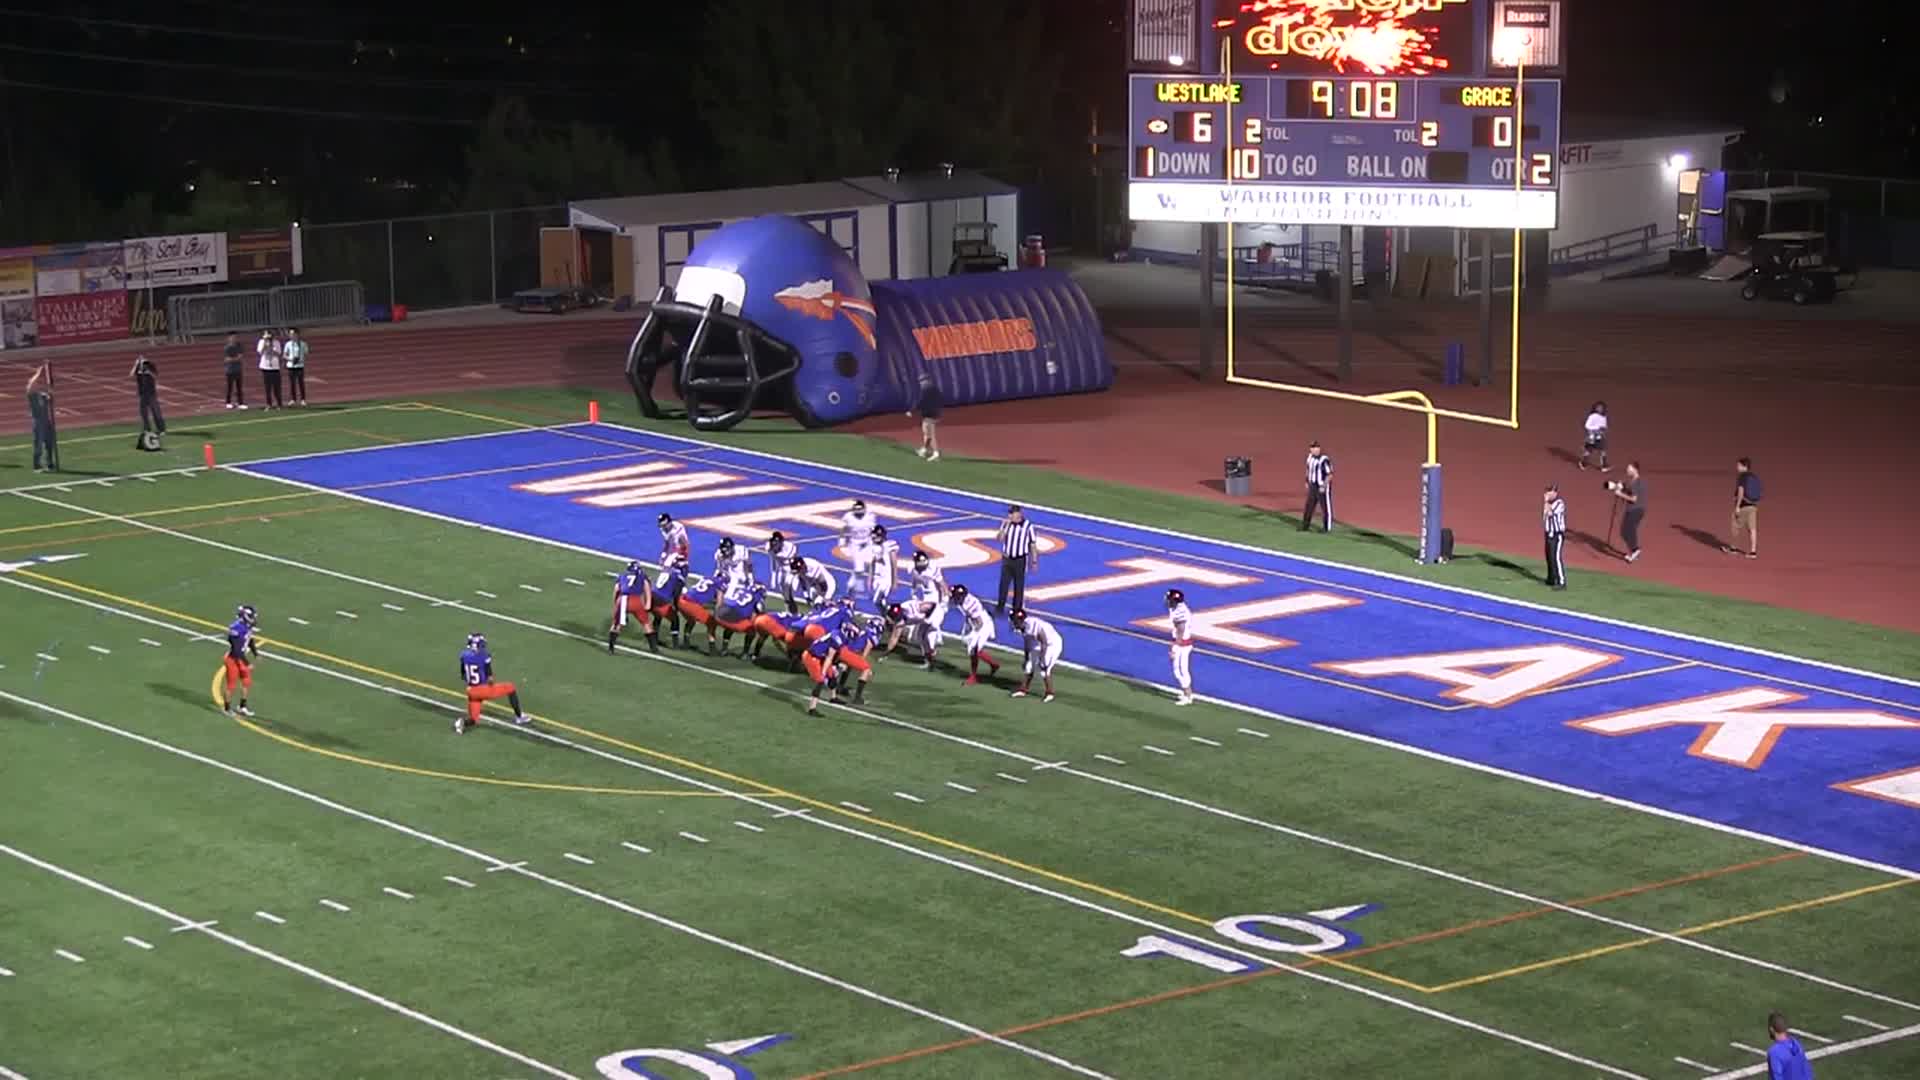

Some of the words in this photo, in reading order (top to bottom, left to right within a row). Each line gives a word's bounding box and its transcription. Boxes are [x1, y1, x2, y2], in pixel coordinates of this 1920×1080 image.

[1157, 83, 1241, 103] WESTLAKE
[1312, 81, 1397, 118] 9:08
[1462, 86, 1512, 106] GRACE
[1193, 113, 1212, 142] 6
[1246, 119, 1261, 143] 2
[1266, 127, 1290, 141] TOL
[1393, 128, 1418, 143] TOL
[1422, 121, 1438, 146] 2
[1493, 116, 1512, 147] 0
[1146, 147, 1154, 176] 1
[1158, 152, 1211, 175] DOWN
[1233, 148, 1260, 179] 10
[1264, 154, 1288, 176] TO
[1292, 155, 1317, 176] GO
[1346, 155, 1395, 178] BALL
[1401, 156, 1427, 179] ON
[1490, 157, 1529, 181] QTR
[1532, 153, 1551, 184] 2
[1219, 189, 1332, 206] WARRIOR
[1344, 191, 1472, 208] FOOTBALL
[143, 431, 161, 450] G
[464, 663, 481, 685] 15
